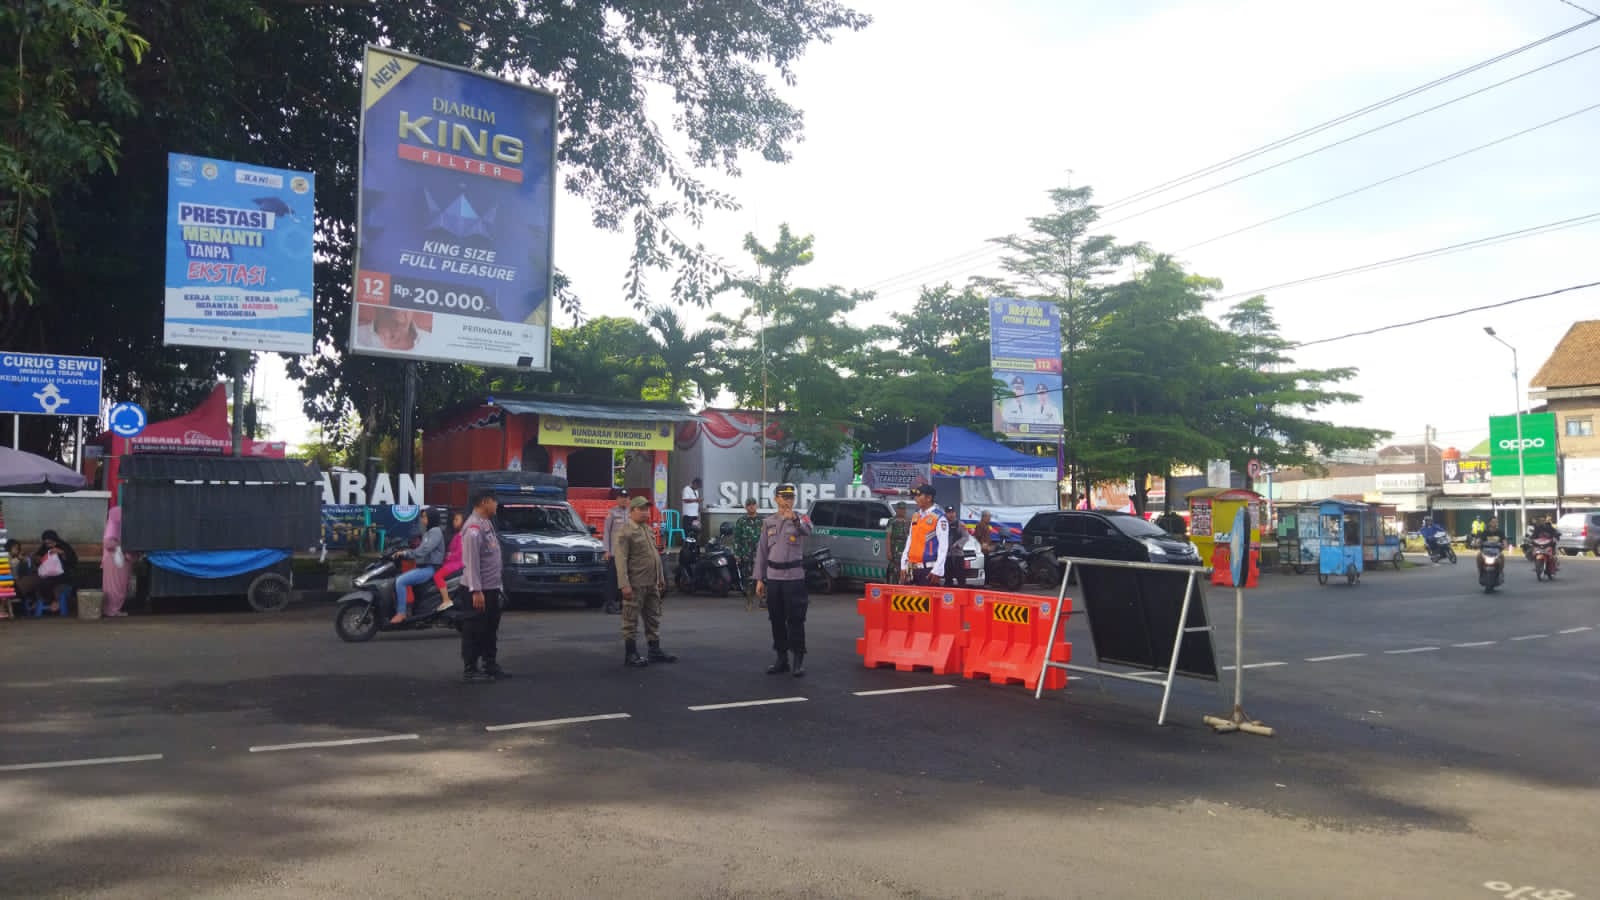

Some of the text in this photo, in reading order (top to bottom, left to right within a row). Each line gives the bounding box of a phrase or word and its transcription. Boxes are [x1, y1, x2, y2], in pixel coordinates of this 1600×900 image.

[371, 58, 401, 88] NEW
[432, 97, 496, 124] DJARUM
[399, 110, 523, 163] KING
[422, 151, 502, 177] FILTER
[180, 205, 267, 228] PRESTASI
[183, 226, 262, 247] MENANTI
[189, 243, 230, 259] TANPA
[424, 240, 496, 262] KING SIZE
[187, 261, 265, 285] EKSTASI
[400, 253, 517, 281] FULL PLEASURE
[362, 278, 385, 296] 12
[3, 356, 98, 371] CURUG SEWU
[1498, 438, 1544, 450] oppo
